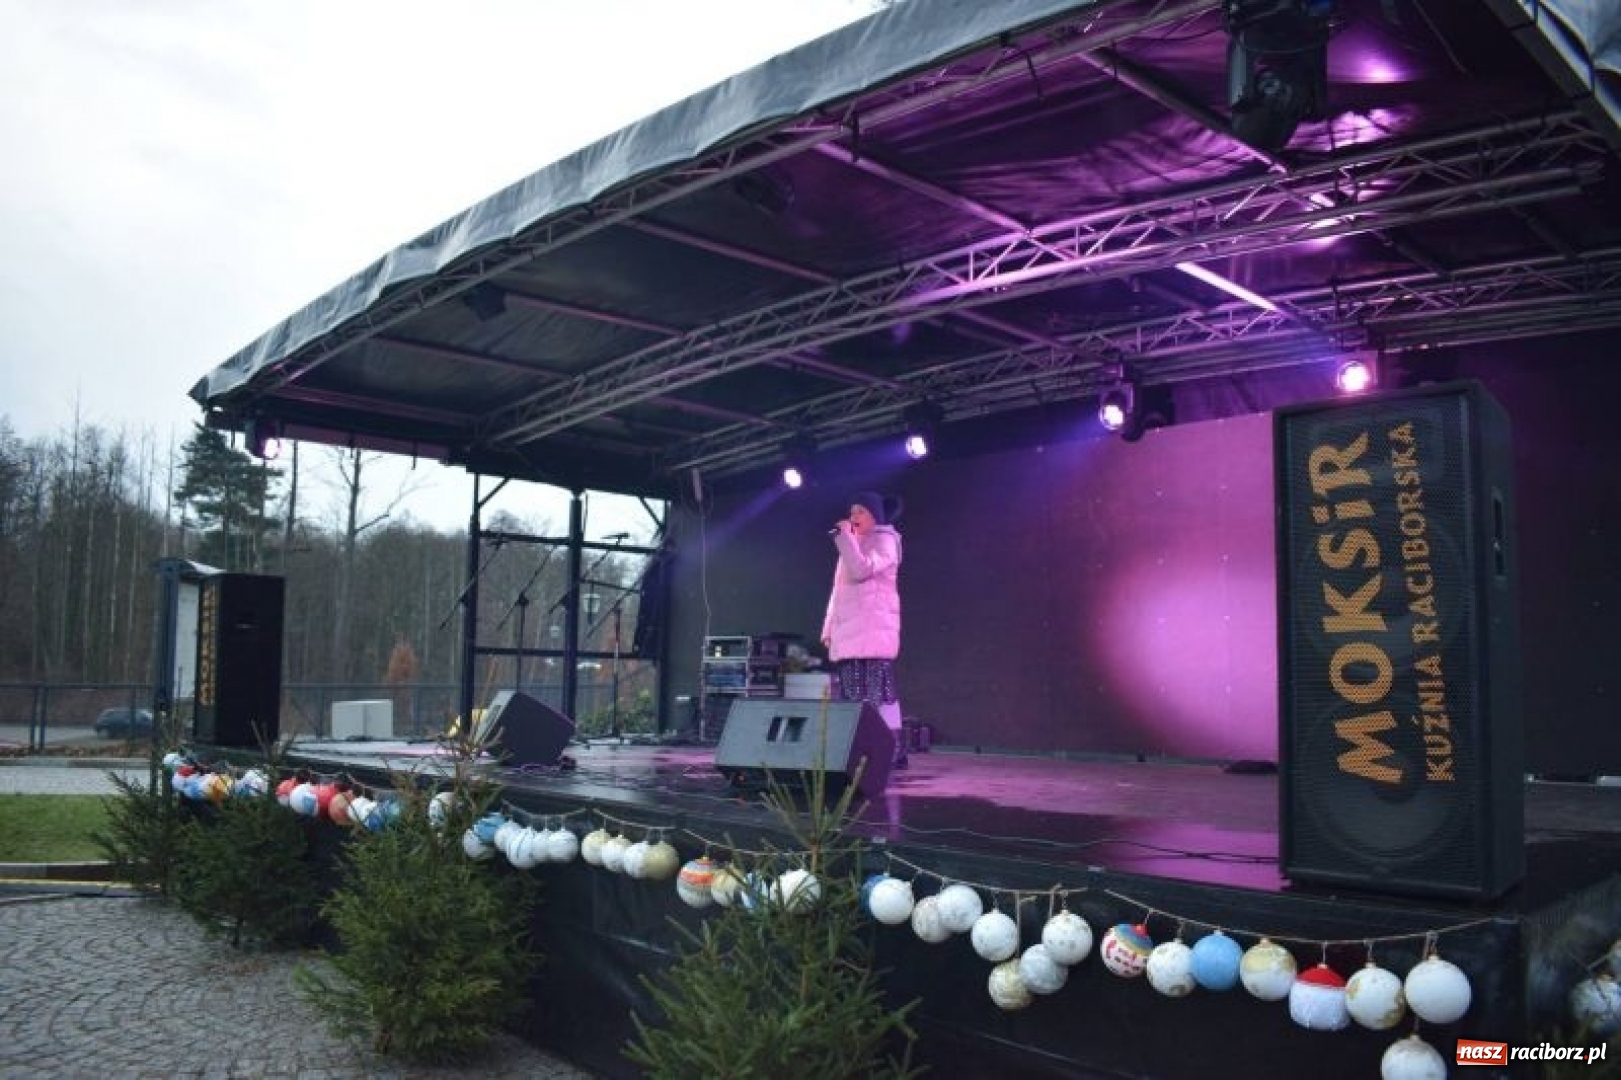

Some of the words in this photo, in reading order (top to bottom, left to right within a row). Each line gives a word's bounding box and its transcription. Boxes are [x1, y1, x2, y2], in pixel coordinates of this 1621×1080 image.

[1309, 432, 1402, 783] MOKSiR
[1388, 421, 1440, 644] RACIBORSKA
[1412, 655, 1455, 781] KUŹNIA
